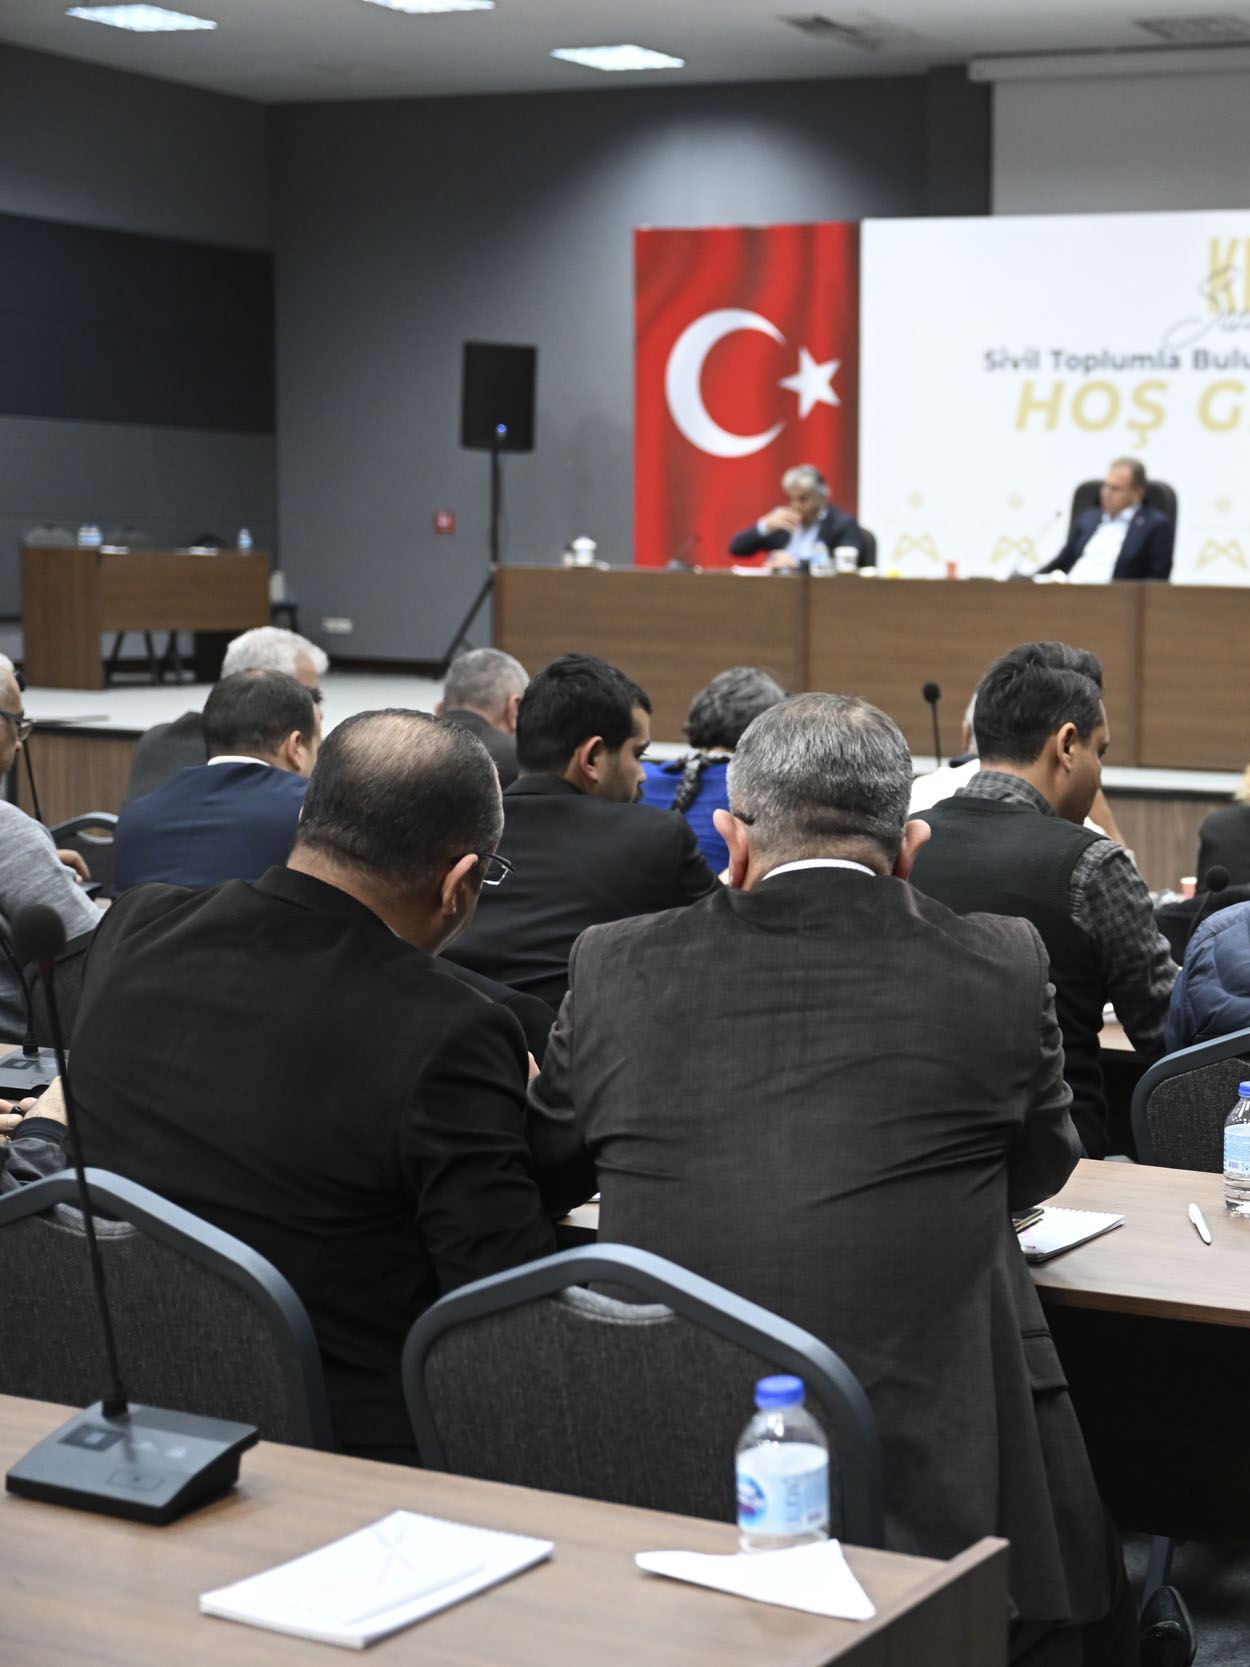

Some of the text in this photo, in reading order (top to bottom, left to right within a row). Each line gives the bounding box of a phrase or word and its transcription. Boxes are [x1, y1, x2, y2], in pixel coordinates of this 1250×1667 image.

[983, 348, 1040, 372] Sivil
[1050, 347, 1181, 376] Toplumla
[1015, 380, 1168, 448] HOŞ
